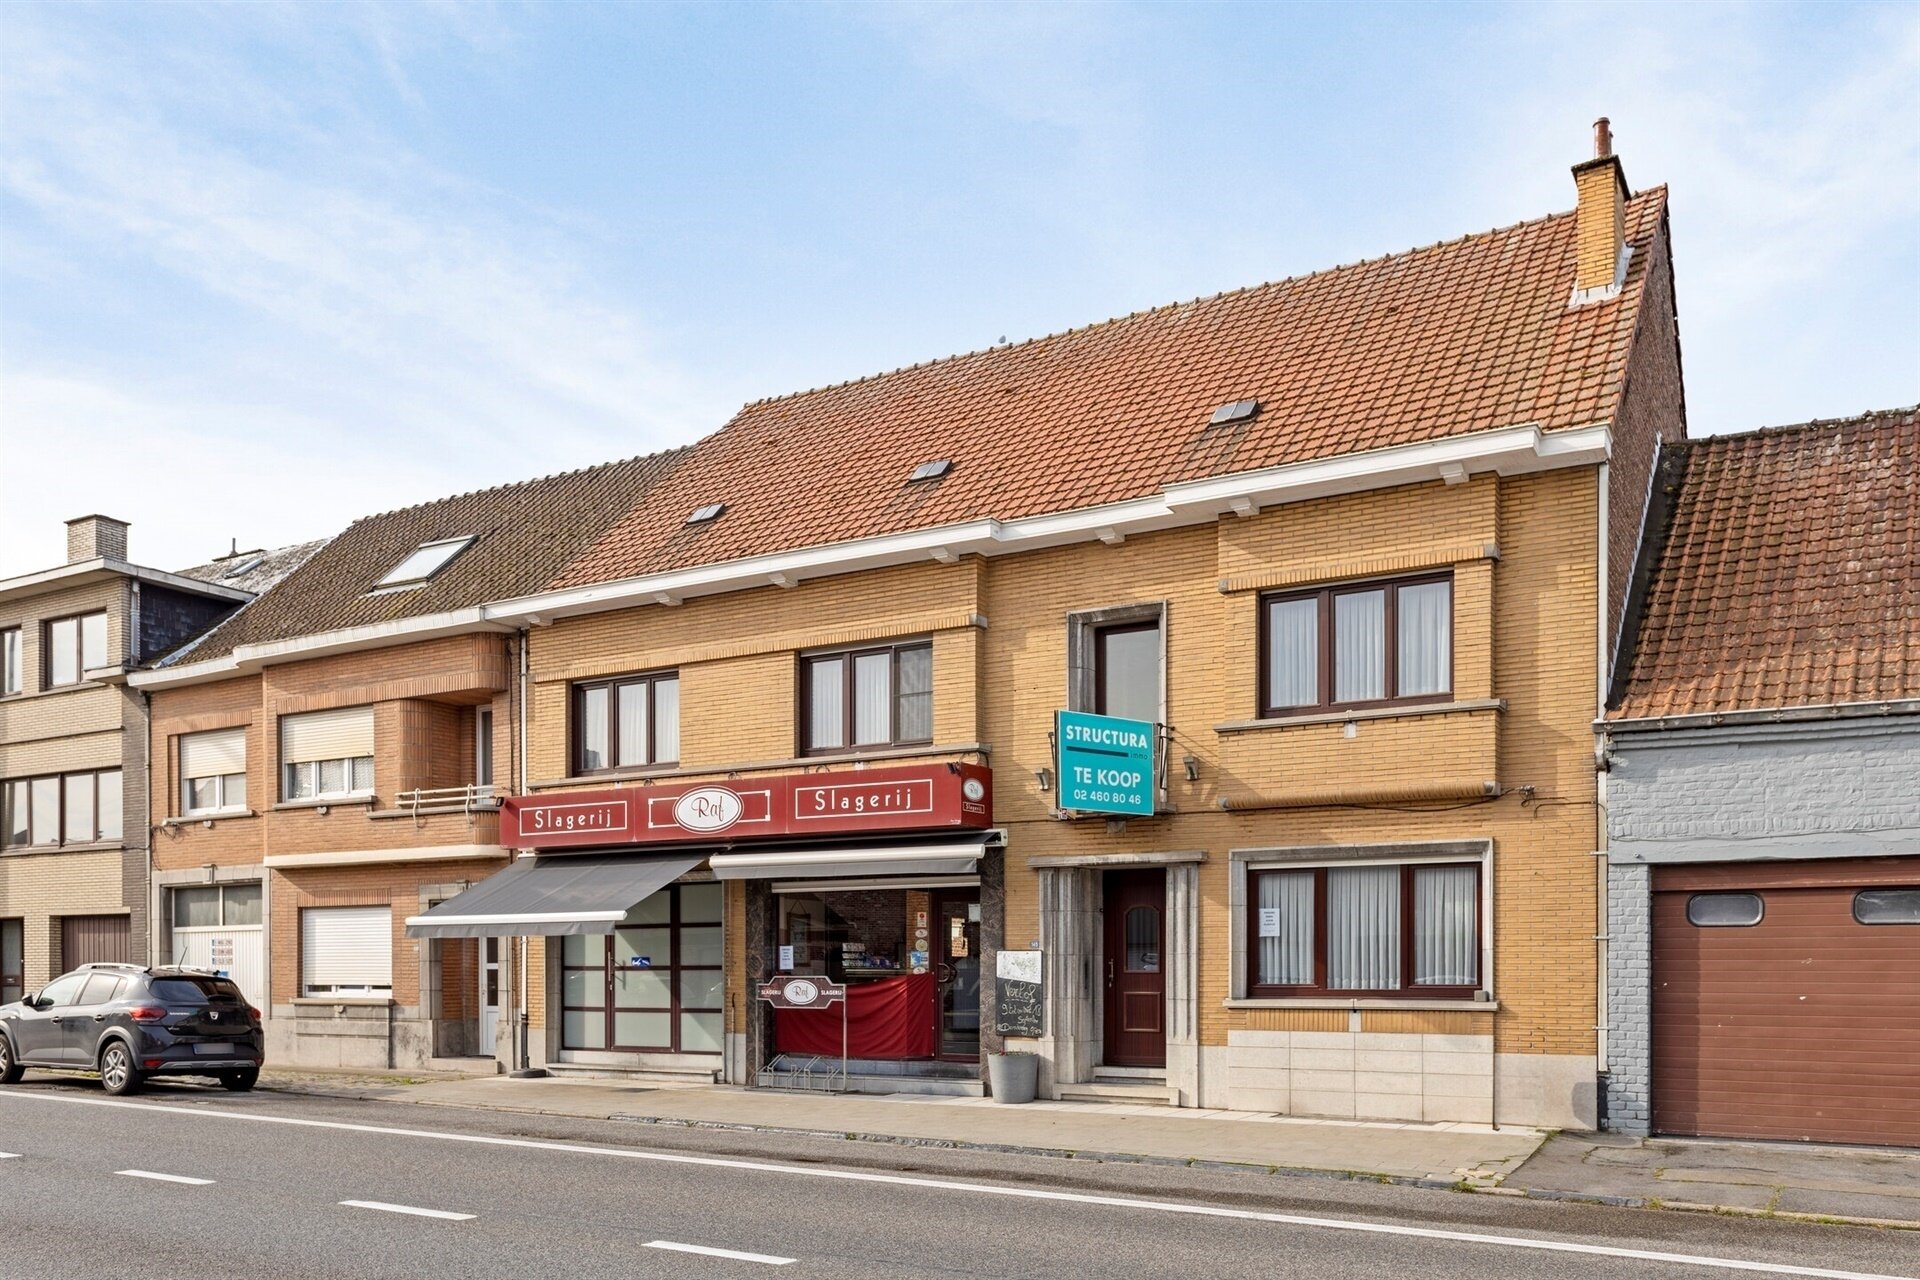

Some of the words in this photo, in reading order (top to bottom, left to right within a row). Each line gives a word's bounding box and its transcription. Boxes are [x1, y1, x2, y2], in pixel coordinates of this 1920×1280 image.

[1066, 725, 1148, 748] STRUCTURA
[1073, 767, 1092, 784] TE
[1097, 769, 1141, 788] KOOP
[815, 788, 911, 811] Slagerij
[1074, 790, 1087, 800] 02
[1112, 793, 1126, 803] 80
[1128, 794, 1142, 805] 46
[534, 810, 612, 829] Slagerij
[691, 796, 725, 822] Raf
